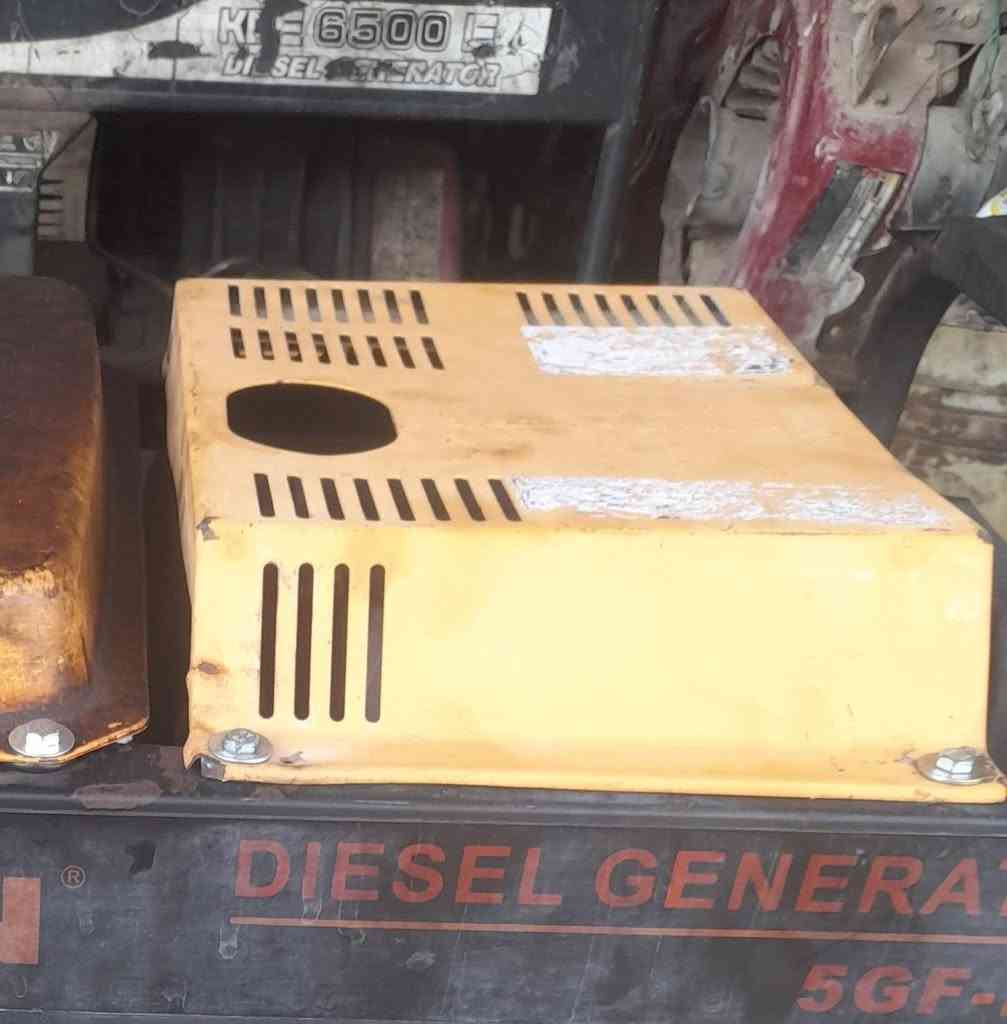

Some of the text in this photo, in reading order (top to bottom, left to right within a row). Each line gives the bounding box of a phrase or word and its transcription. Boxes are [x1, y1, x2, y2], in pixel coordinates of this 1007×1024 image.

[314, 5, 451, 51] 6500
[223, 52, 322, 80] DISEL
[235, 839, 1007, 921] DIESEL GENERA
[796, 964, 1007, 1017] 5GF-
